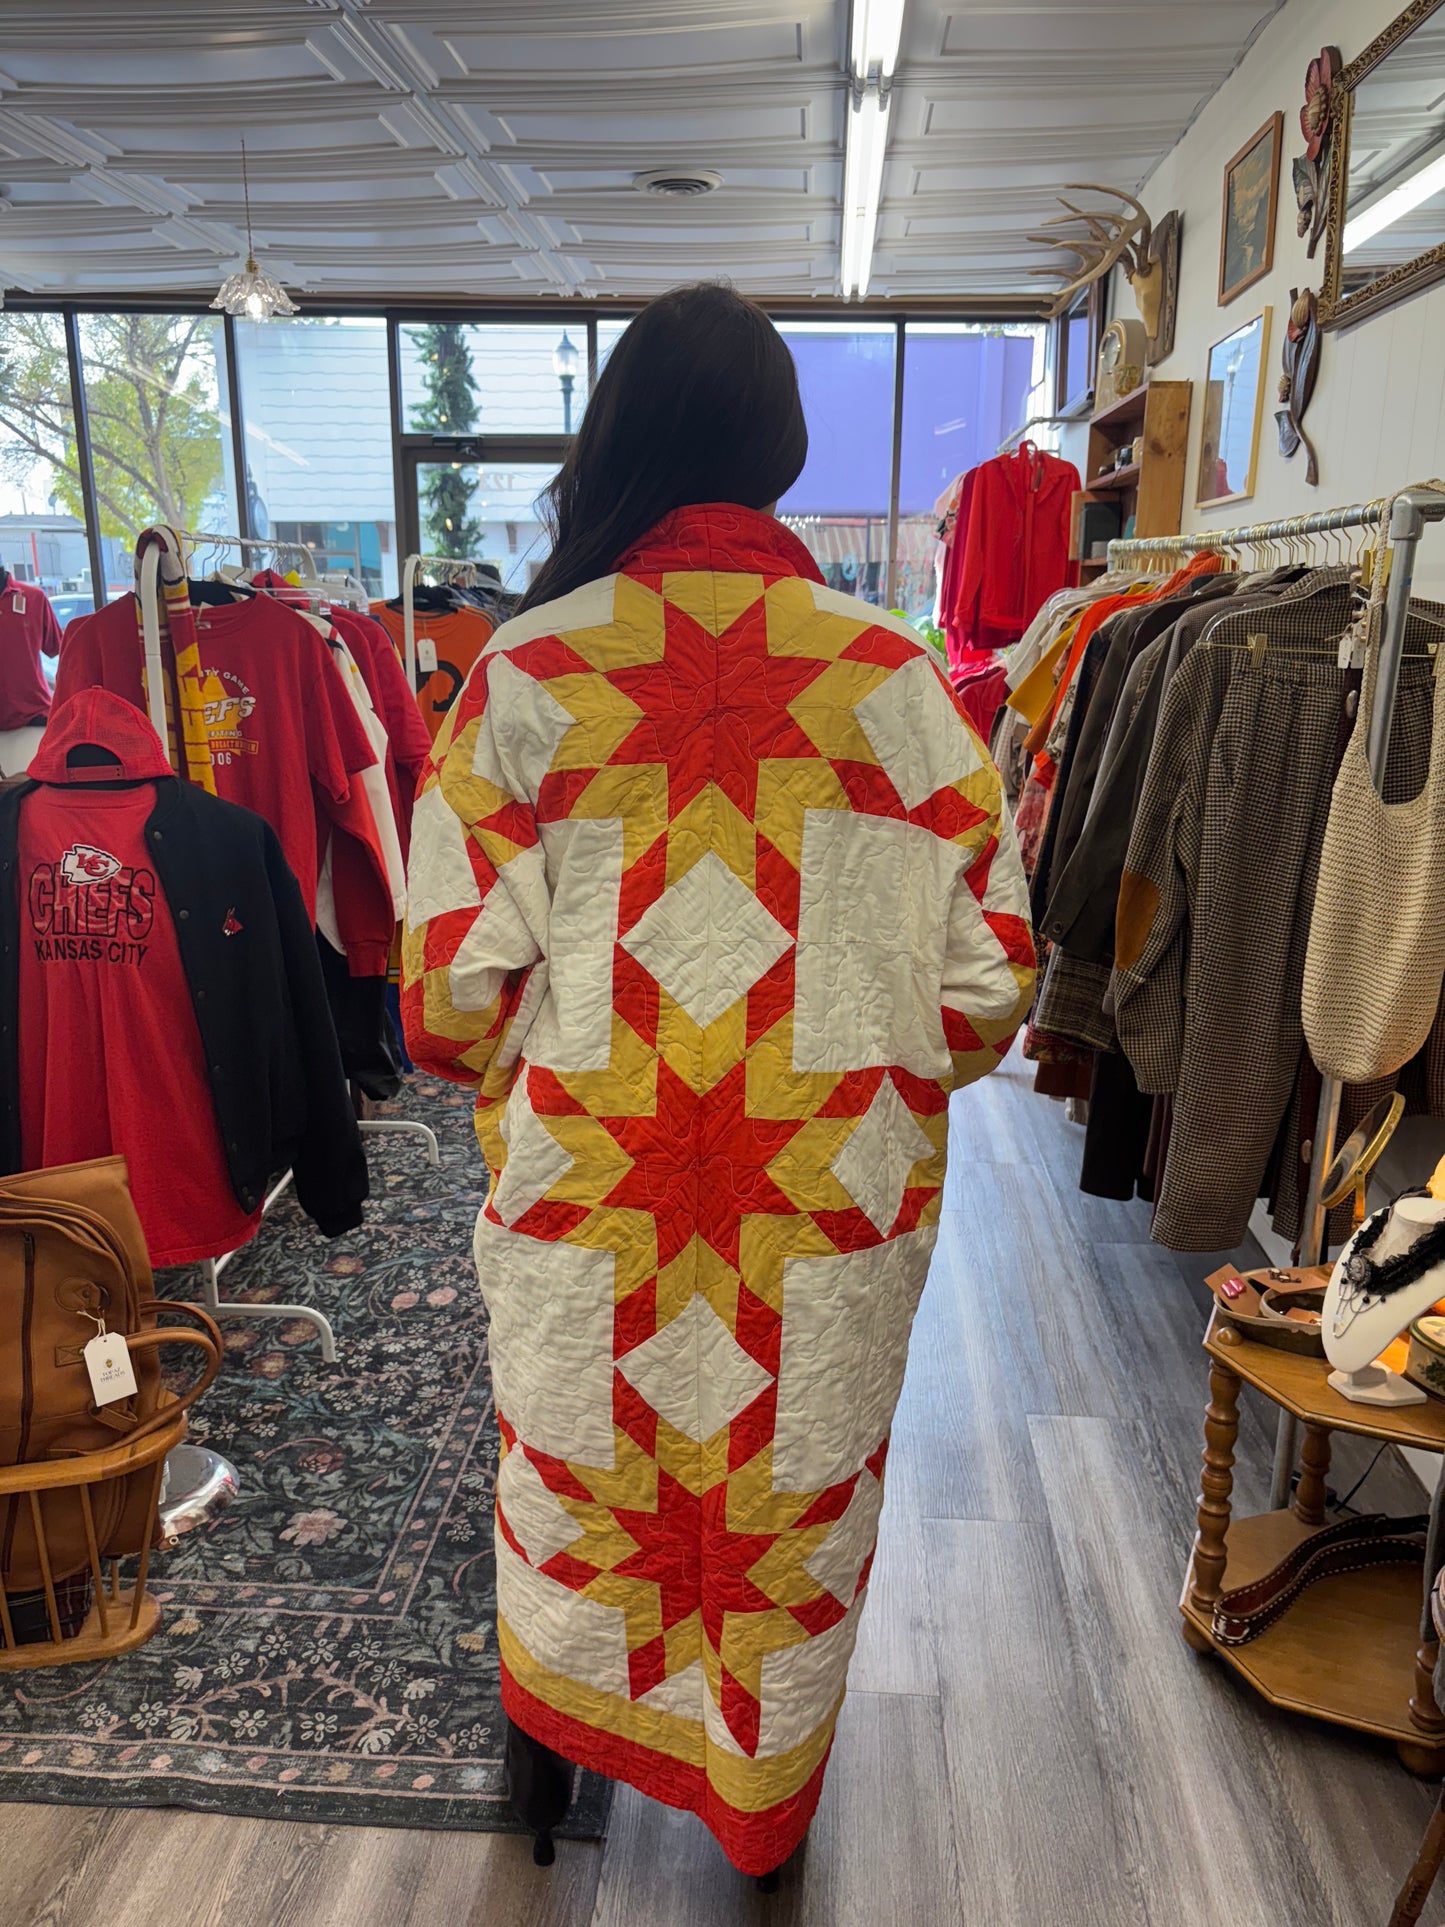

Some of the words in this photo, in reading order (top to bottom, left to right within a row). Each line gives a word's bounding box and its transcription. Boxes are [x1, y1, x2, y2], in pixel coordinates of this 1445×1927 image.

[77, 853, 109, 877] KC
[29, 862, 155, 940] CHIEFS
[34, 938, 102, 961] KANSAS
[108, 941, 148, 966] CITY
